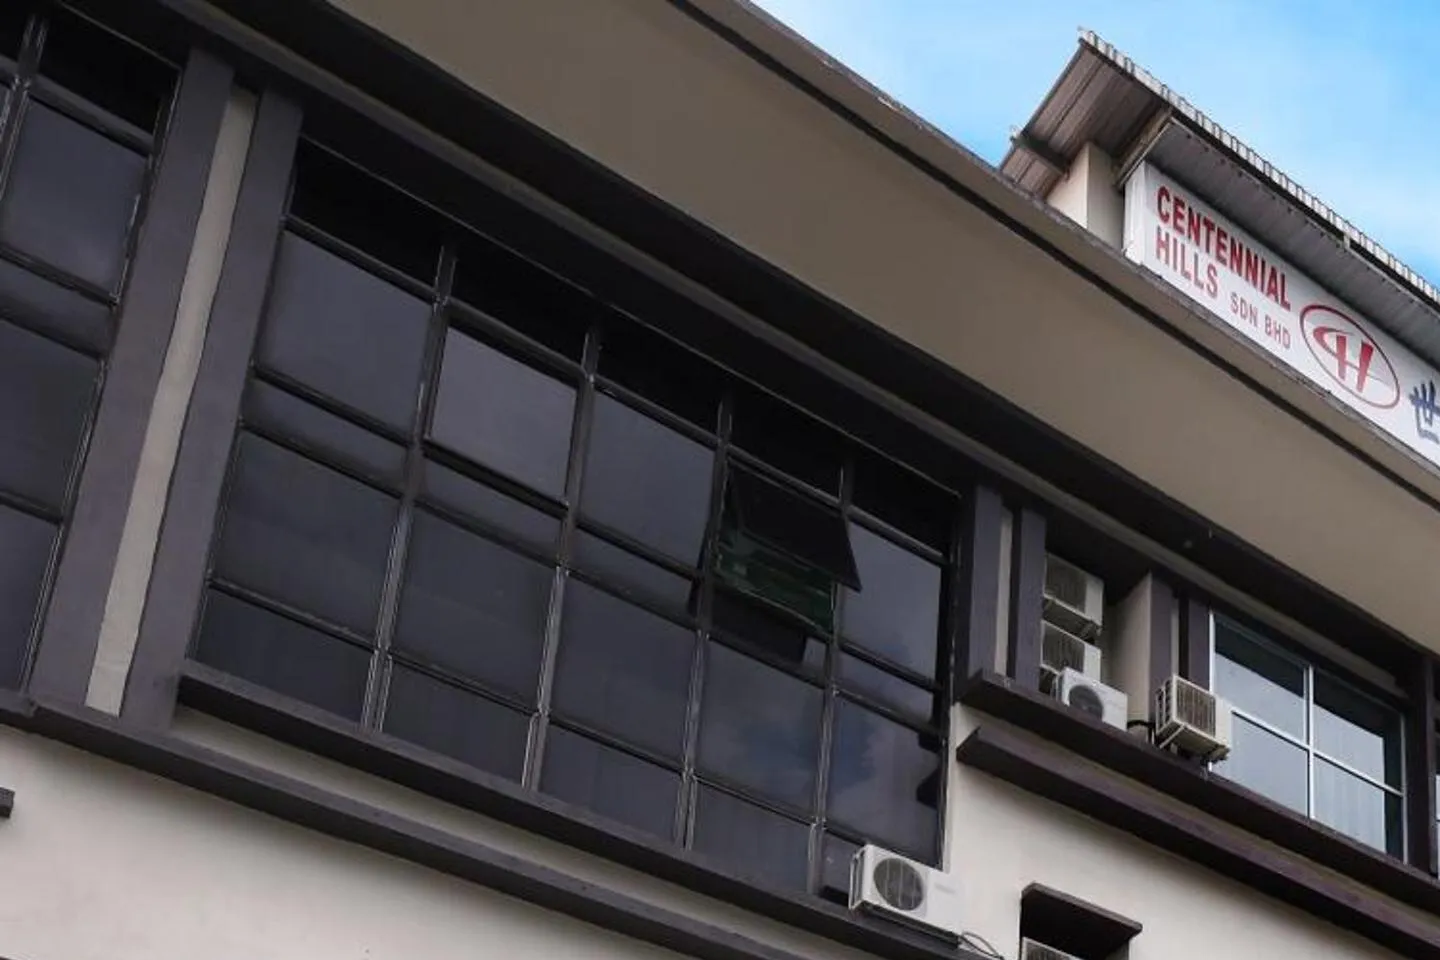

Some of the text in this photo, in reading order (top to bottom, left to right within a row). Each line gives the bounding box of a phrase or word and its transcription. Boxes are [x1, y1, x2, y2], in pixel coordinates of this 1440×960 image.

[1156, 225, 1291, 350] HILLS SDN BHD
[1157, 185, 1291, 310] CENTENNIAL
